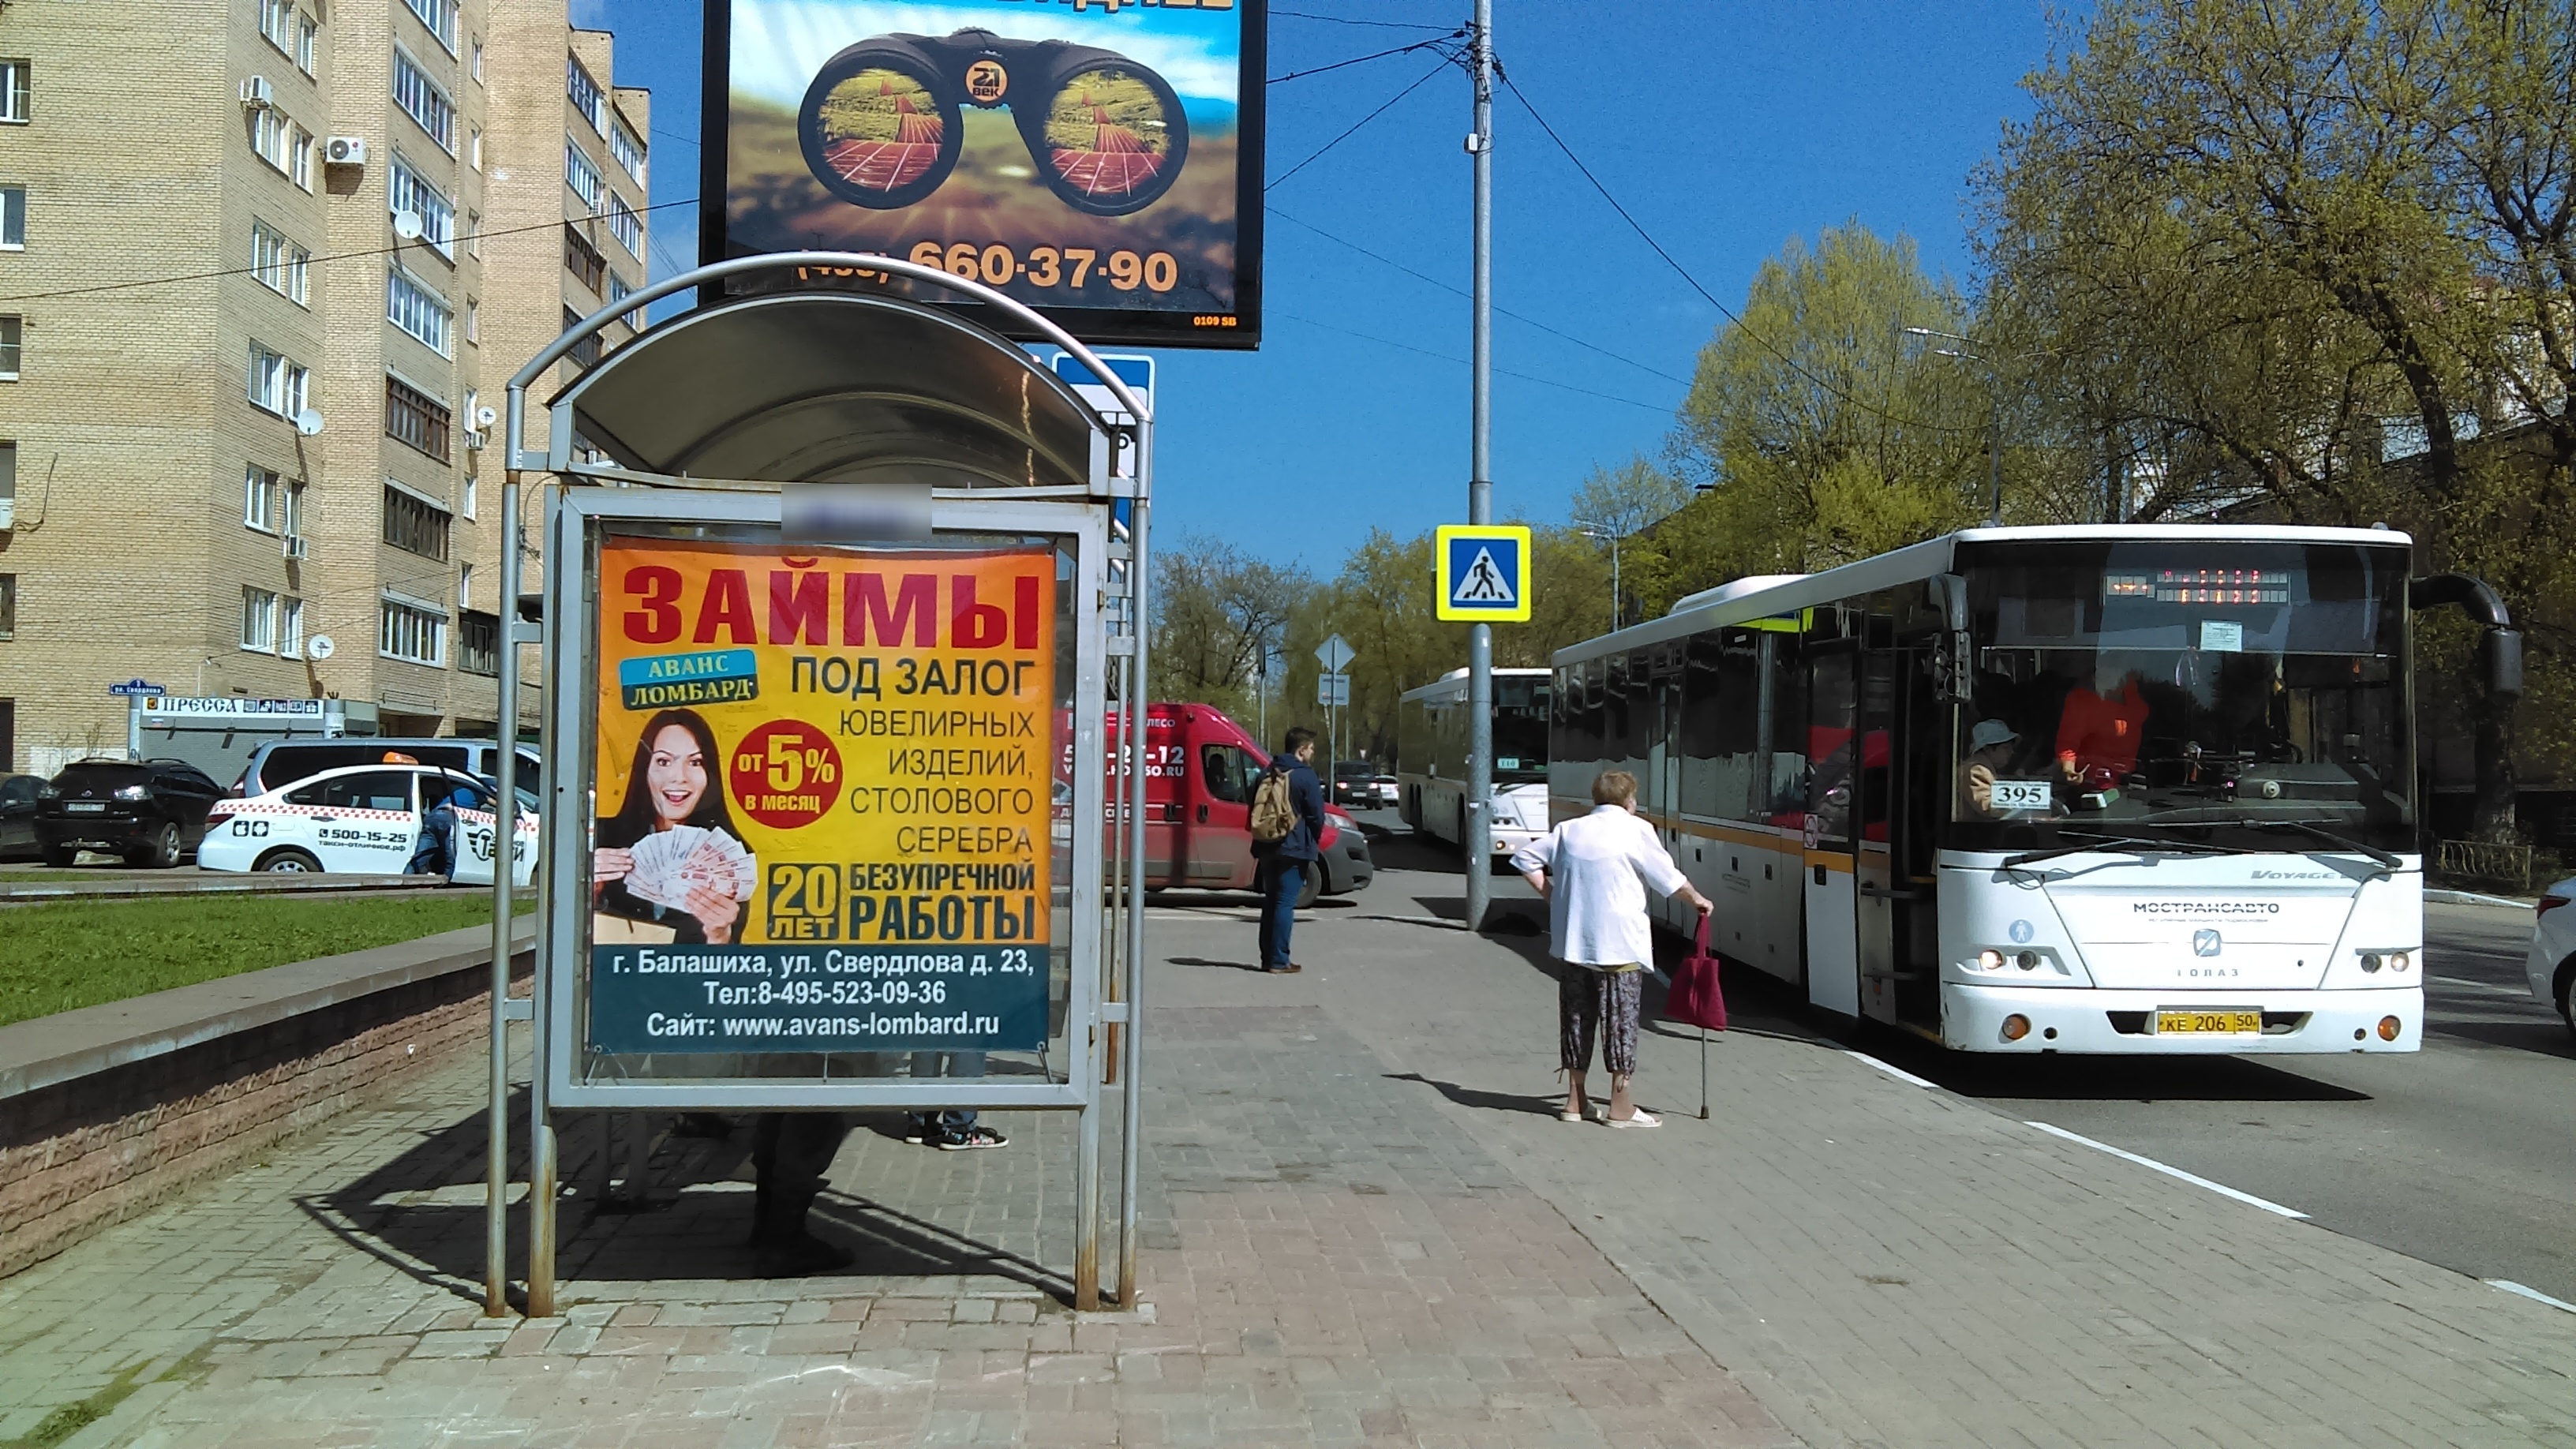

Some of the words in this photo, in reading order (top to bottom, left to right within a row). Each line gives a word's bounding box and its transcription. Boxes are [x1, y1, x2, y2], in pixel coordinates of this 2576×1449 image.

[973, 67, 1000, 87] 21
[1193, 316, 1219, 326] 0109
[1222, 316, 1237, 326] SB
[623, 556, 1039, 650] ЗАЙМЫ
[648, 655, 728, 678] АВАНС
[791, 657, 882, 701] ПОД
[896, 657, 1035, 696] ЗАЛОГ
[631, 679, 751, 706] ЛОМБАРД
[163, 699, 238, 713] ПРЕССА
[840, 710, 1035, 737] ЮВЕЛИРНЫХ
[739, 754, 763, 773] от
[768, 735, 835, 792] 5%
[889, 745, 1033, 781] ИЗДЕЛИЙ,
[745, 795, 756, 811] в
[762, 795, 821, 814] месяц
[851, 787, 1033, 814] СТОЛОВОГО
[1998, 787, 2042, 803] 395
[331, 829, 407, 843] 500-15-25
[897, 826, 1033, 853] СЕРЕБРА
[850, 859, 1035, 891] БЕЗУПРЕЧНОЙ
[773, 866, 837, 915] 20
[849, 895, 1035, 940] РАБОТЫ
[2133, 903, 2280, 913] МОСТРАНСАВТО
[771, 918, 833, 938] ЛЕТ
[612, 957, 632, 974] г.
[638, 950, 773, 977] Балашиха,
[780, 956, 816, 979] ул.
[825, 949, 964, 979] Свердлова
[970, 956, 994, 978] д.
[1000, 949, 1035, 976] 23,
[703, 981, 946, 1005] Тел:8-495-523-09-36
[646, 1012, 716, 1037] Сайт:
[724, 1011, 1000, 1037] www.avans-lombard.ru
[2166, 1018, 2188, 1032] КЕ
[2194, 1015, 2226, 1032] 206
[2237, 1014, 2253, 1027] 50
